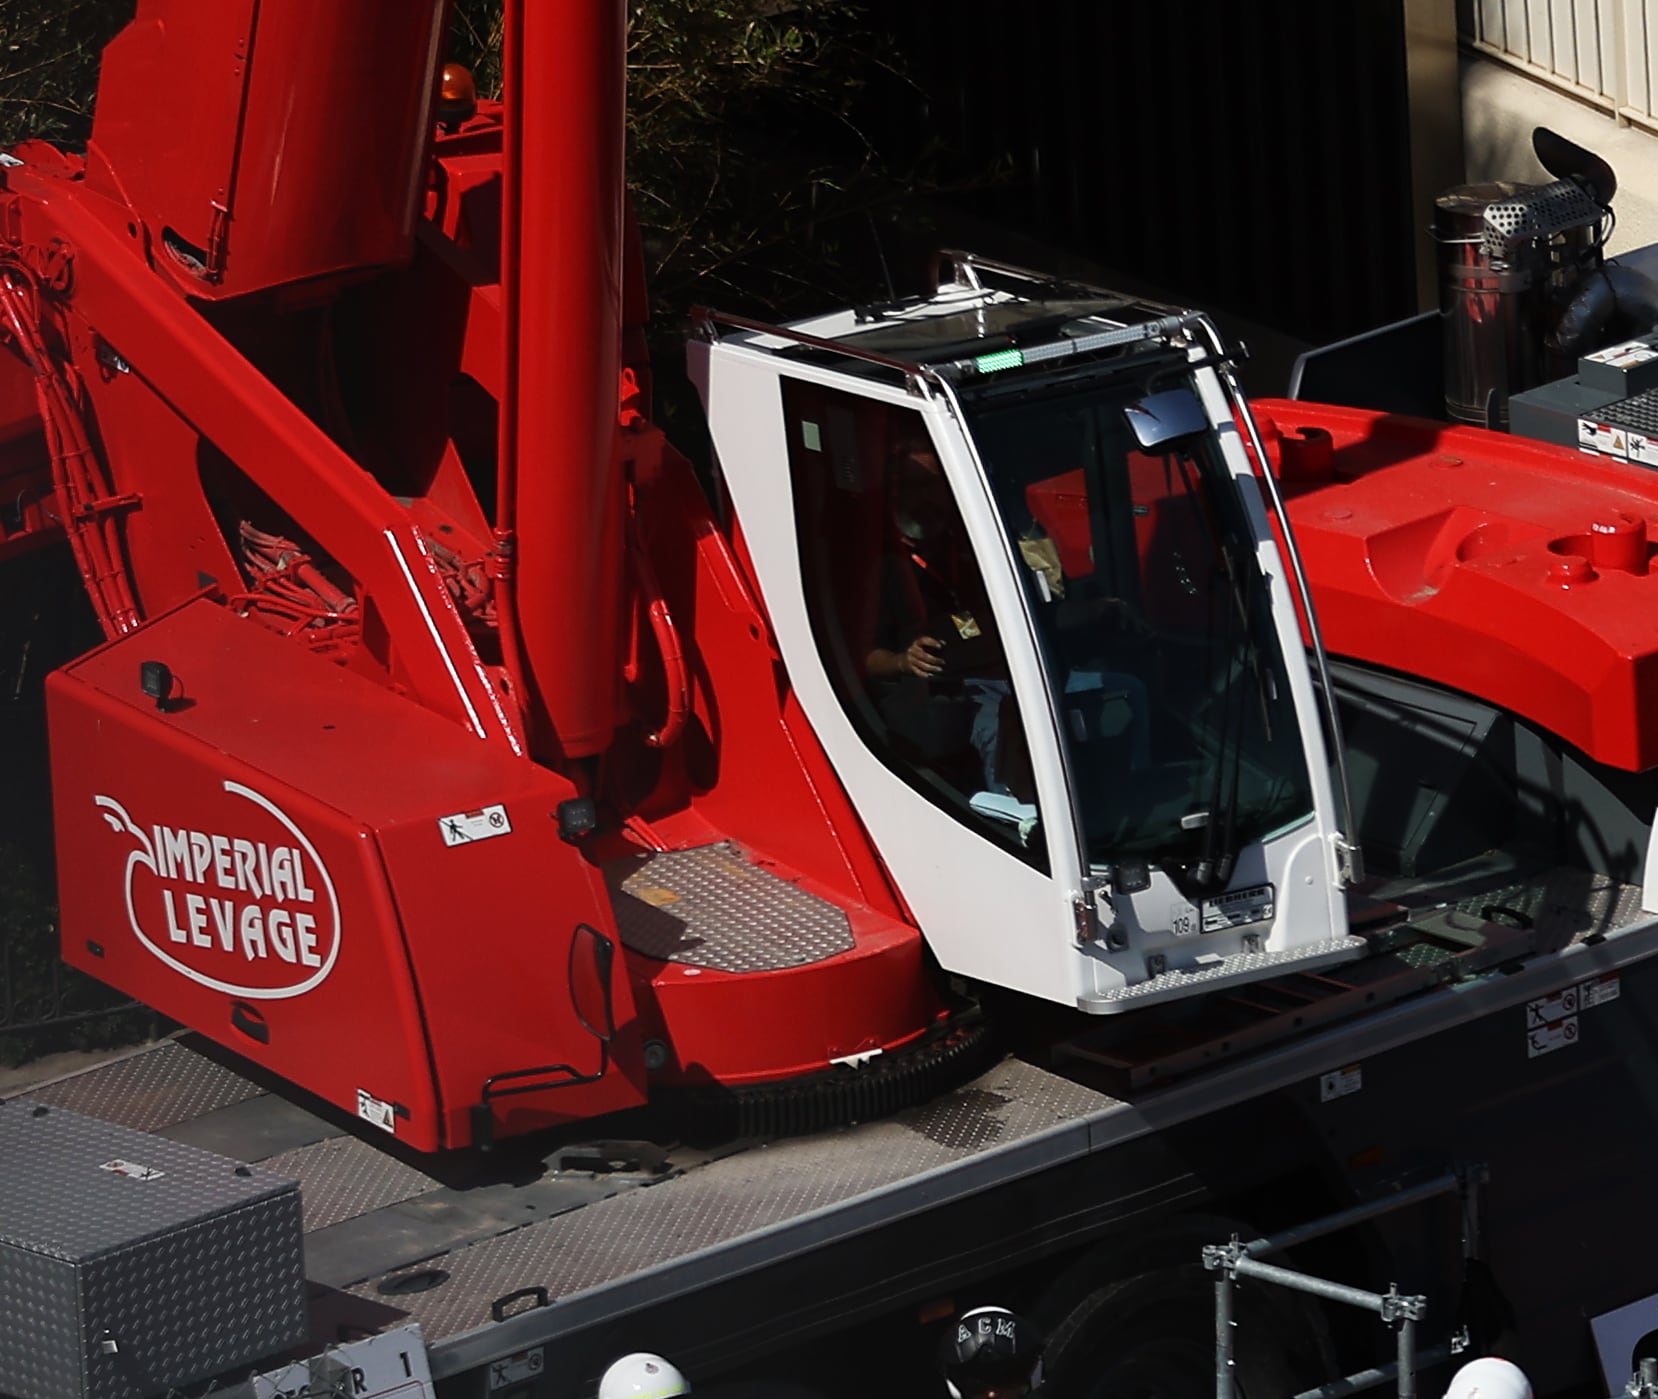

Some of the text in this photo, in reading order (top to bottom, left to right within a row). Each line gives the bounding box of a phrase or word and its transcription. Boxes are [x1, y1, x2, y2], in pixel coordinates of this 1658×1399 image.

[152, 824, 316, 904] IMPERIAL
[163, 888, 323, 968] LEVAGE
[399, 1351, 413, 1378] 1
